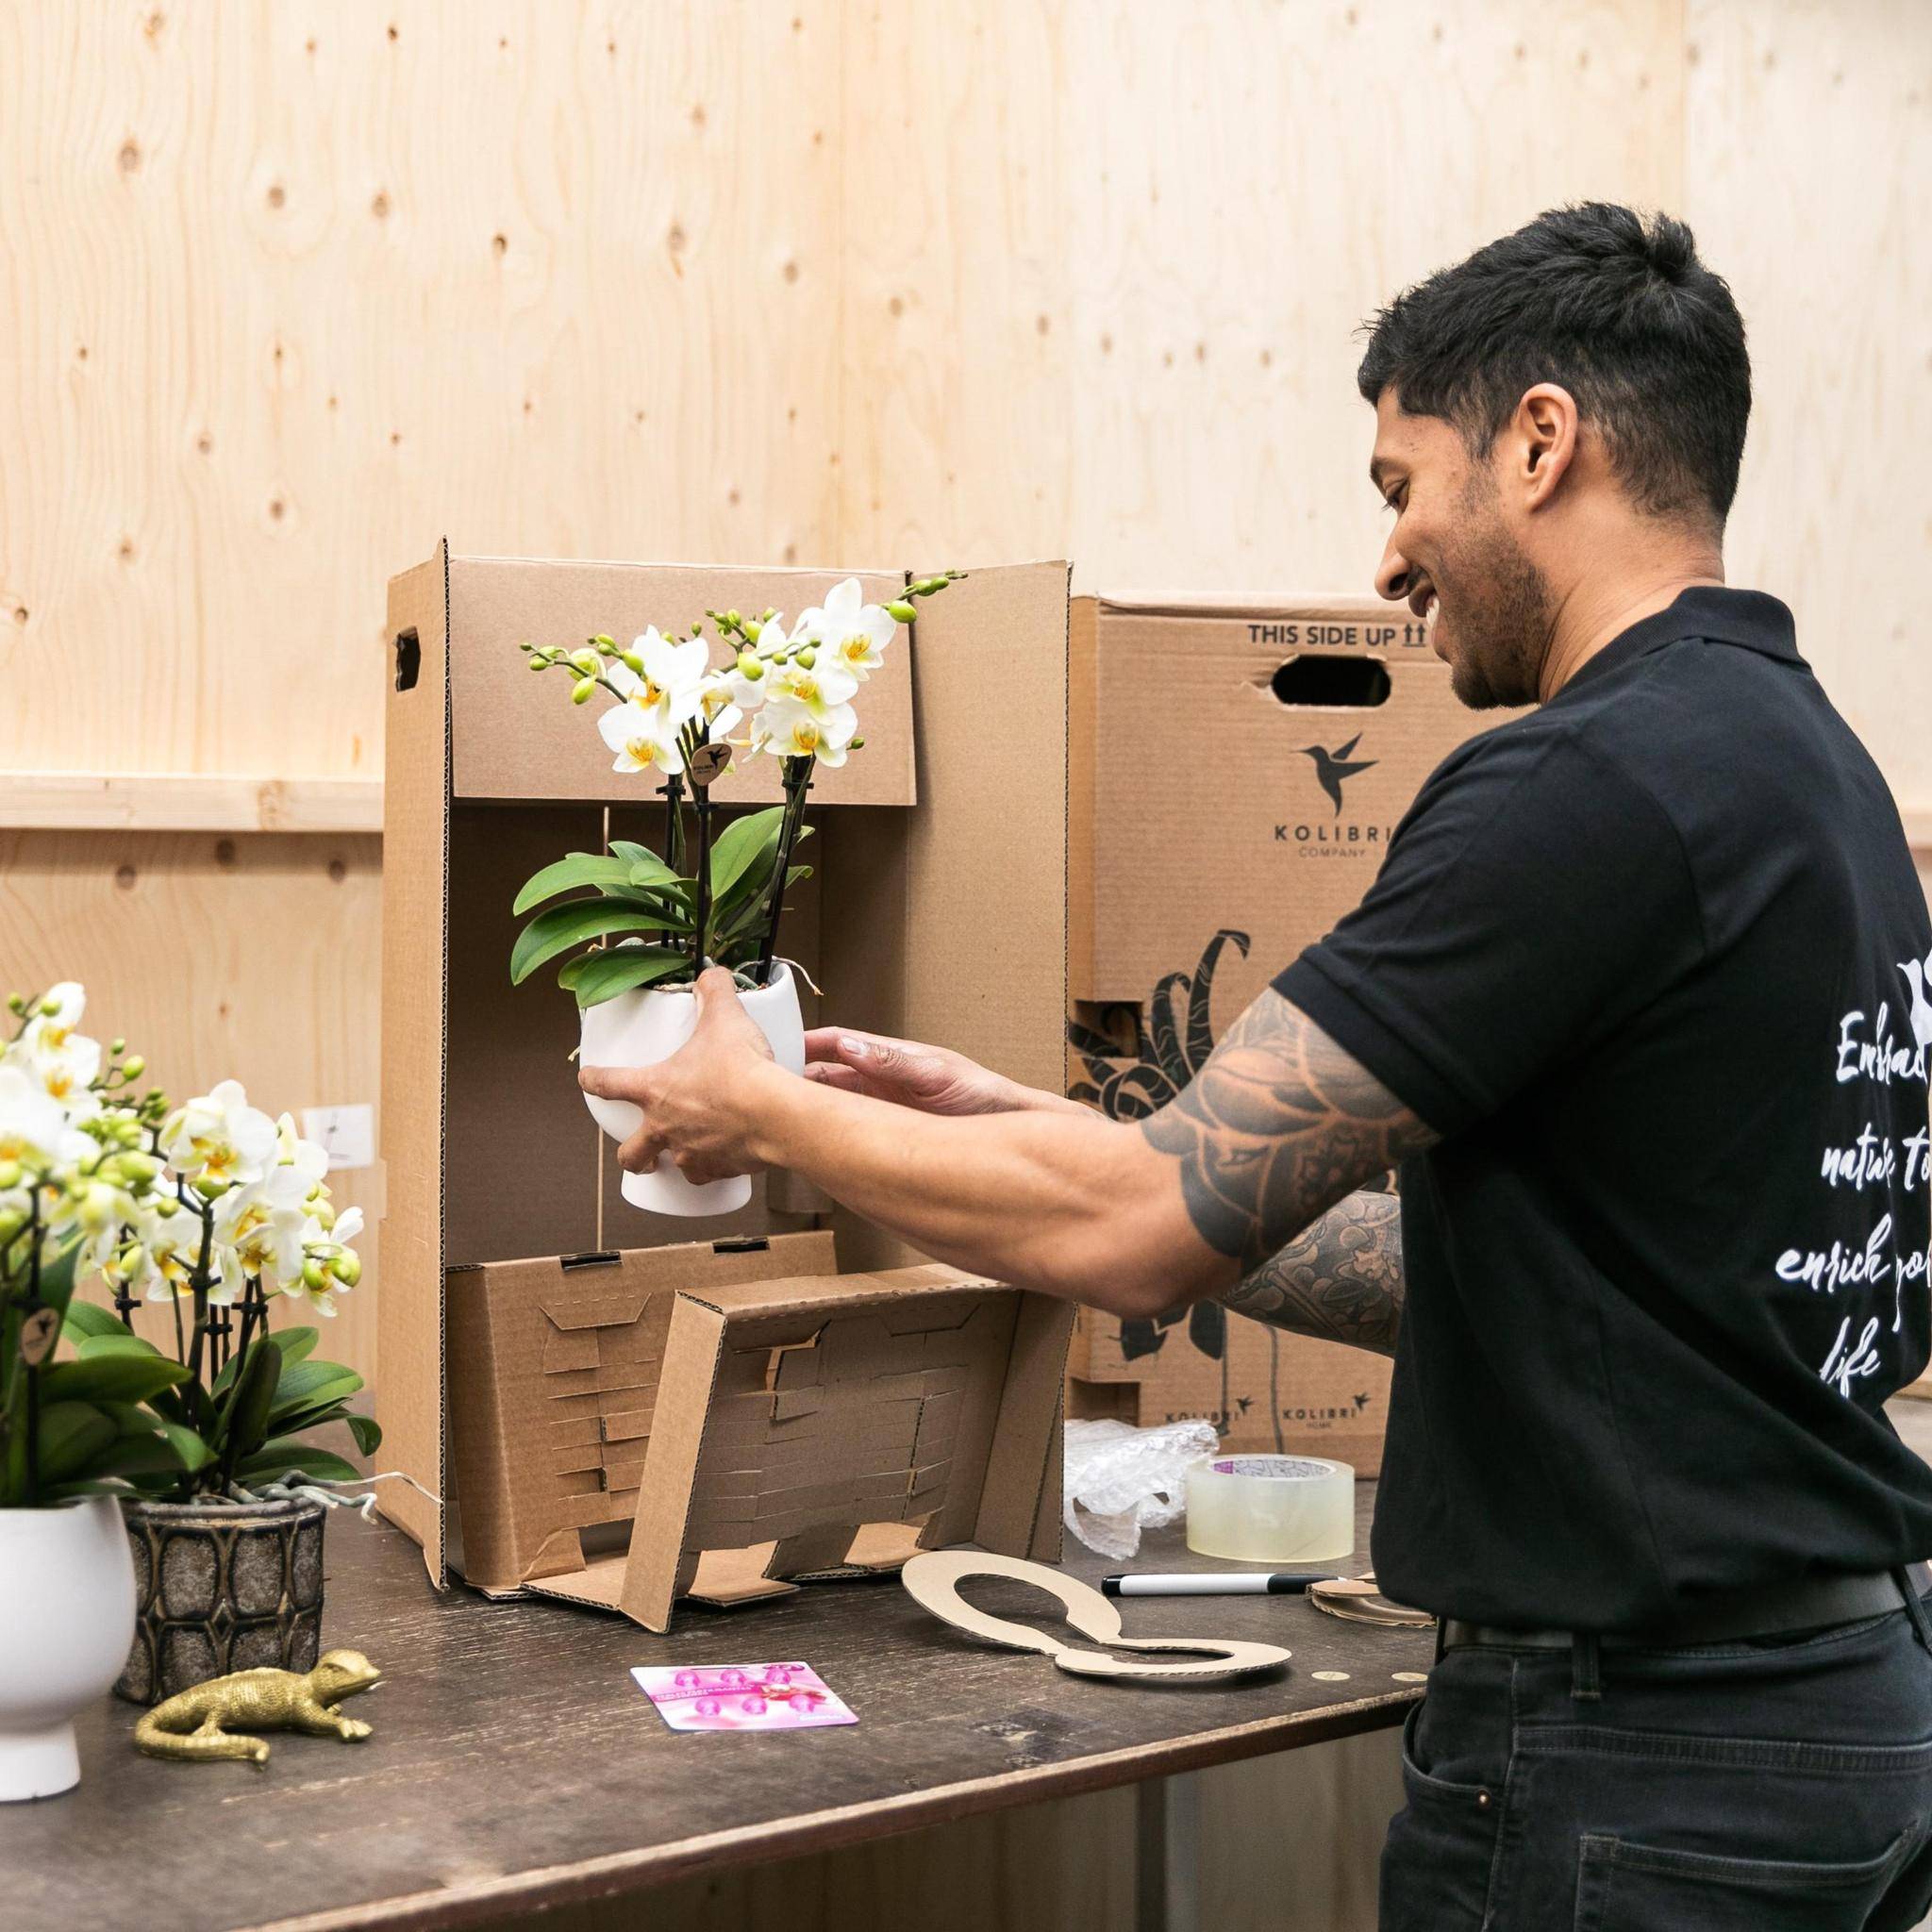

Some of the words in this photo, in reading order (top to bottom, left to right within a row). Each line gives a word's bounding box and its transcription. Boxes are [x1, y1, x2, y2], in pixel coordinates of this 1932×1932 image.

[1248, 625, 1299, 644] THIS
[1307, 626, 1357, 645] SIDE
[1366, 628, 1396, 647] UP
[1274, 824, 1391, 842] KOLIBRI
[1299, 847, 1366, 858] COMPANY
[1775, 1213, 1891, 1293] enrich
[1283, 1407, 1357, 1421] KOLIBRI
